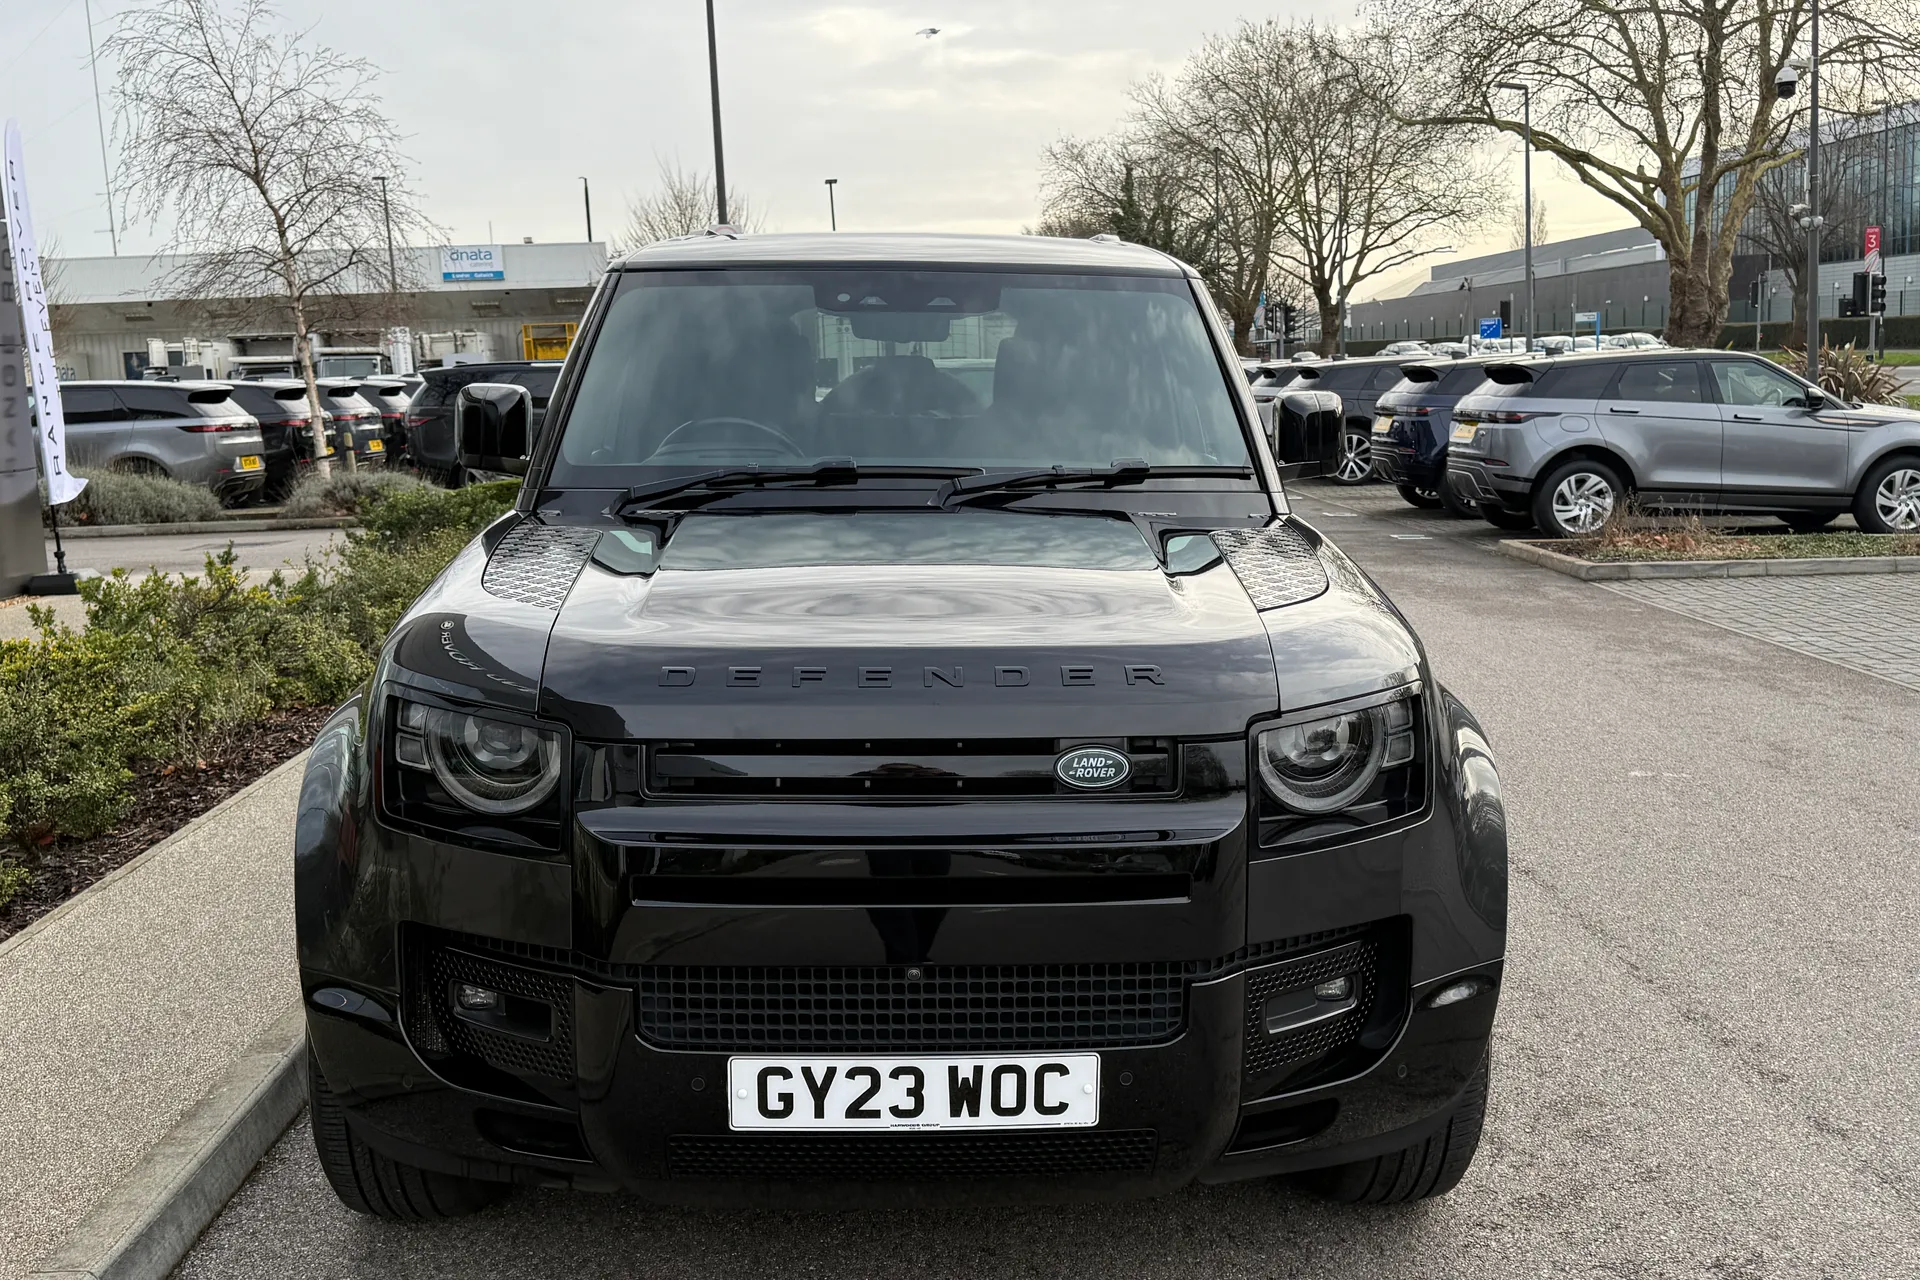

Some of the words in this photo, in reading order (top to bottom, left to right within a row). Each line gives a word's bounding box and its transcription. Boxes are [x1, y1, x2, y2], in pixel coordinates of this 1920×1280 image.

[1868, 234, 1877, 248] 3
[450, 248, 492, 261] dnata
[56, 362, 76, 381] nata
[33, 332, 61, 475] RANGE
[658, 664, 1166, 688] DEFENDER
[1072, 757, 1105, 768] LAND
[1075, 767, 1116, 778] ROVER
[756, 1066, 925, 1120] GY23
[948, 1063, 1070, 1118] WOC
